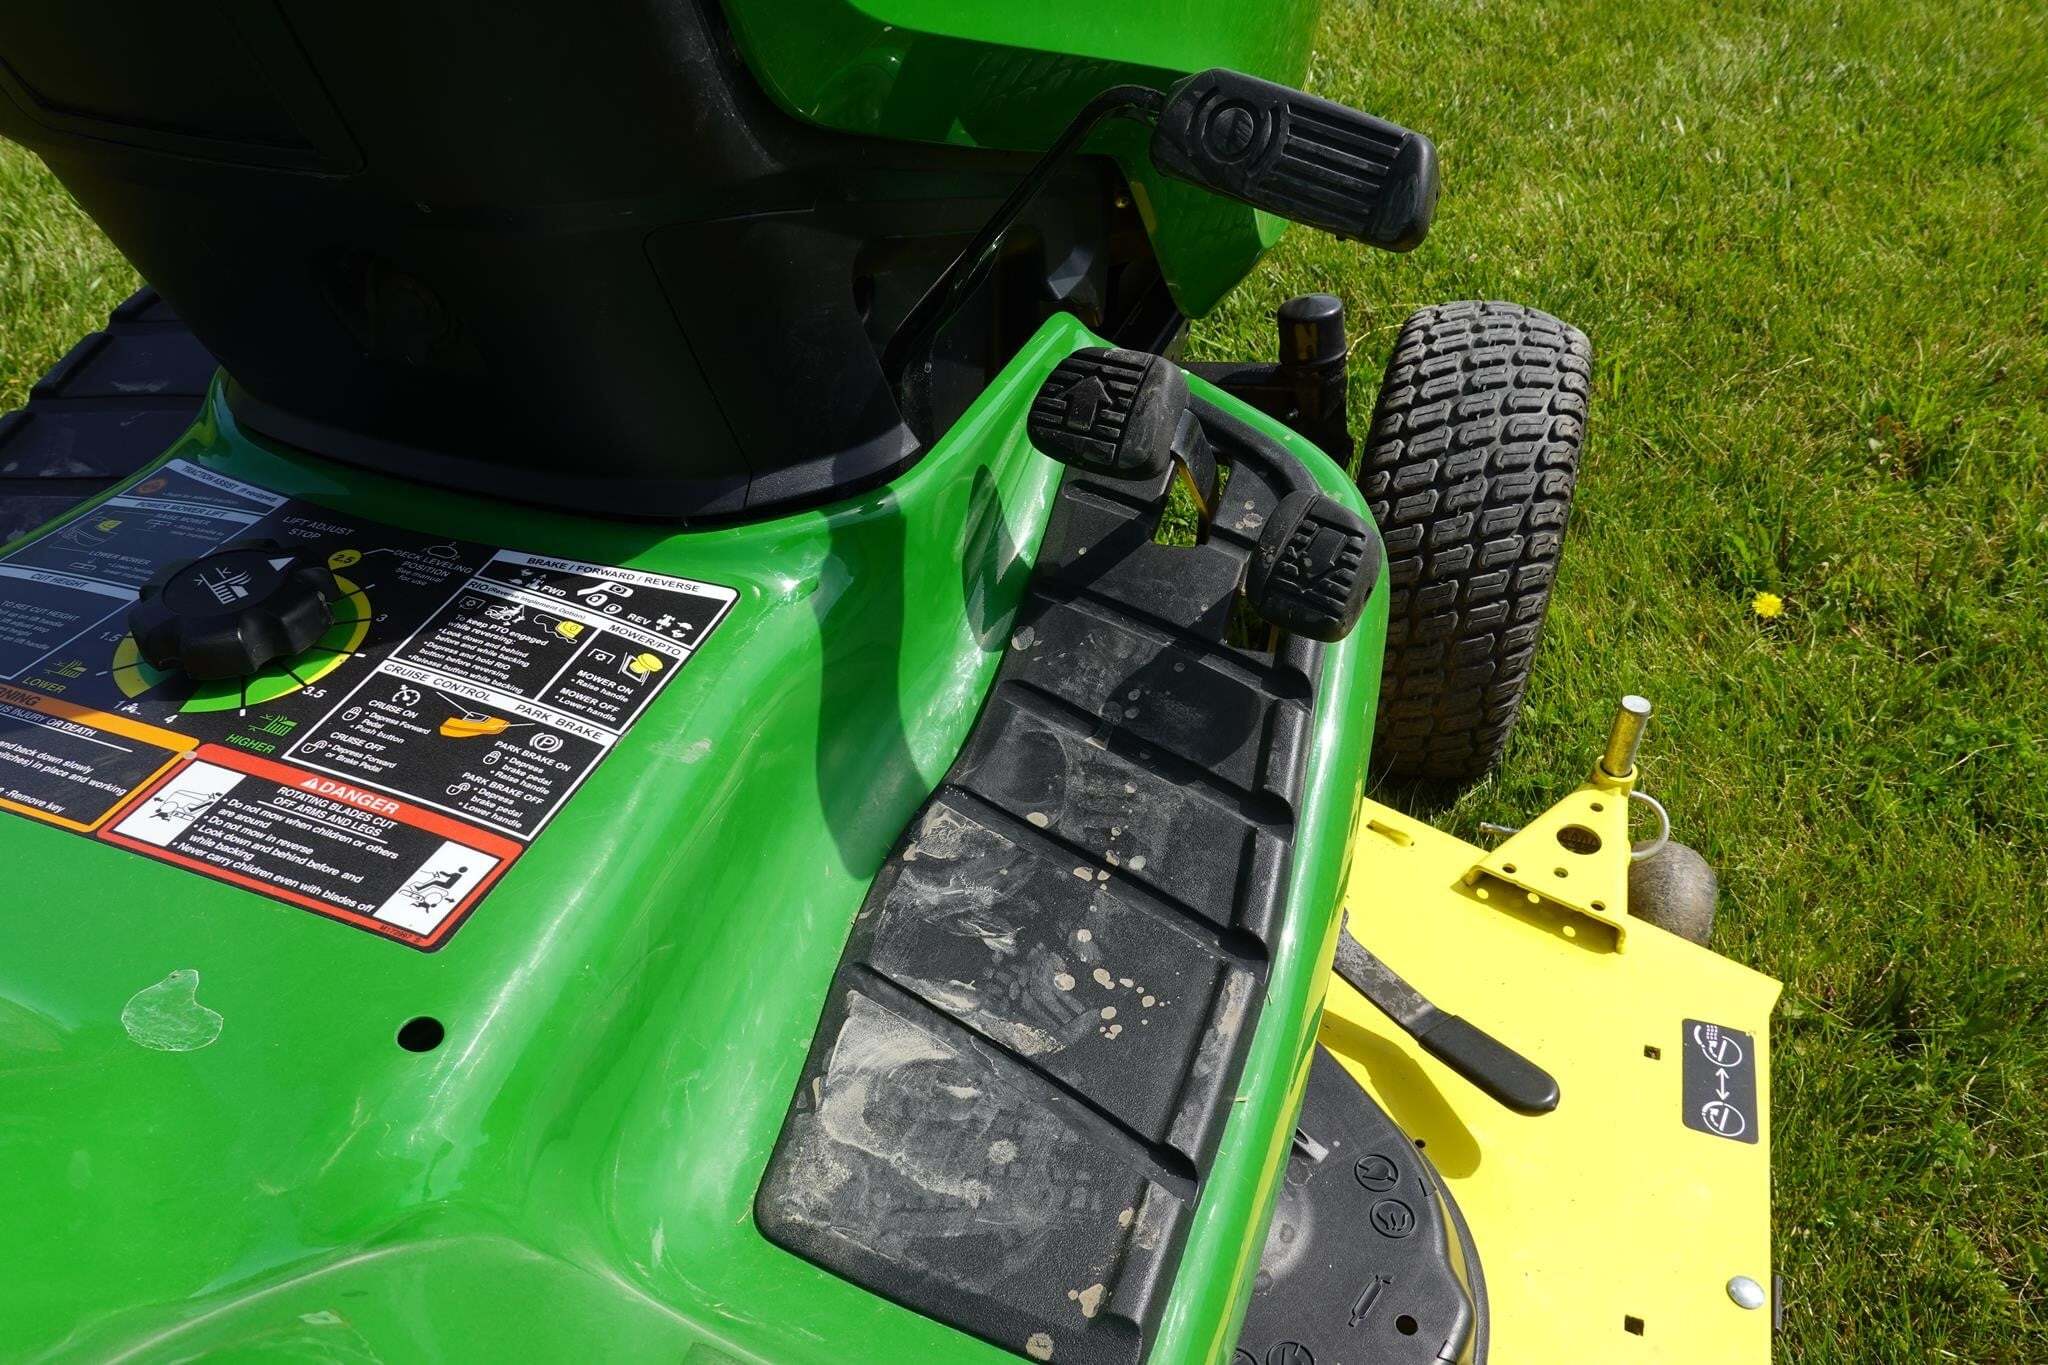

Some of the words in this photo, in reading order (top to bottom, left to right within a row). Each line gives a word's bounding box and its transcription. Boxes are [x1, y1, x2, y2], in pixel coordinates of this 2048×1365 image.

[282, 515, 309, 527] LIFT
[307, 521, 355, 536] ADJUST
[288, 529, 321, 540] STOP
[401, 561, 449, 577] POSITION
[422, 557, 474, 574] LEVELING
[526, 557, 567, 570] BRAKE
[576, 564, 636, 582] FORWARD
[642, 576, 701, 592] REVERSE
[468, 581, 489, 591] RIO
[540, 585, 567, 598] FWD
[376, 613, 388, 623] 3
[456, 613, 466, 622] To
[466, 618, 489, 630] keep
[489, 623, 510, 634] PTO
[509, 630, 549, 647] engaged
[627, 612, 651, 625] REV
[100, 631, 122, 642] 1.5
[440, 628, 461, 639] Look
[461, 633, 485, 645] down
[484, 640, 501, 651] and
[499, 644, 530, 658] behind
[449, 620, 471, 632] while
[471, 627, 517, 645] reversing:
[608, 624, 681, 657] MOWER/PTO
[427, 641, 460, 656] Depress
[459, 650, 476, 662] and
[475, 655, 495, 667] hold
[494, 660, 511, 671] RIO
[435, 634, 461, 647] before
[460, 641, 477, 652] and
[476, 646, 498, 658] while
[497, 651, 530, 668] backing
[411, 653, 442, 669] Release
[442, 662, 469, 677] button
[469, 670, 491, 684] while
[491, 678, 524, 695] backing
[418, 648, 445, 661] button
[444, 655, 472, 669] before
[470, 663, 510, 681] reversing
[22, 677, 67, 694] LOWER
[302, 685, 327, 699] 3.5
[384, 663, 431, 682] CRUISE
[433, 677, 492, 702] CONTROL
[575, 679, 600, 693] Raise
[600, 688, 629, 703] handle
[577, 669, 617, 689] MOWER
[616, 683, 634, 695] ON
[0, 687, 40, 707] NING
[369, 699, 404, 714] CRUISE
[402, 708, 419, 720] ON
[558, 695, 587, 711] Lower
[586, 706, 617, 722] handle
[560, 687, 599, 706] MOWER
[598, 700, 621, 714] OFF
[11, 707, 49, 722] INJURY
[46, 718, 62, 728] OR
[60, 721, 97, 738] DEATH
[164, 713, 178, 724] 4
[361, 718, 385, 730] Pedal
[369, 711, 399, 726] Depress
[398, 721, 431, 736] Forward
[514, 704, 553, 723] PARK
[555, 717, 605, 740] BRAKE
[224, 733, 276, 754] HIGHER
[330, 731, 367, 747] CRUISE
[365, 741, 386, 752] OFF
[355, 723, 378, 736] Push
[377, 730, 405, 745] button
[16, 744, 38, 757] back
[36, 751, 63, 765] down
[62, 756, 94, 775] slowly
[325, 751, 336, 760] or
[336, 755, 360, 768] Brake
[358, 761, 383, 774] Pedal
[331, 744, 362, 759] Depress
[362, 753, 397, 769] Forward
[494, 740, 522, 755] PARK
[521, 750, 556, 767] BRAKE
[555, 762, 572, 773] ON
[509, 756, 544, 775] Depress
[31, 760, 43, 770] in
[40, 764, 70, 778] place
[68, 771, 91, 784] and
[88, 778, 128, 797] working
[494, 770, 519, 785] Raise
[519, 779, 550, 796] handle
[502, 764, 527, 778] brake
[526, 773, 553, 787] pedal
[317, 780, 400, 815] DANGER
[462, 771, 490, 787] PARK
[488, 781, 524, 799] BRAKE
[523, 793, 545, 806] OFF
[478, 787, 515, 806] Depress
[45, 802, 66, 814] key
[218, 808, 236, 818] are
[234, 813, 272, 829] around
[272, 796, 297, 808] OFF
[294, 803, 328, 820] ARMS
[325, 813, 352, 828] AND
[350, 822, 382, 837] LEGS
[277, 786, 328, 808] ROTATING
[327, 801, 372, 822] BLADES
[371, 816, 398, 830] CUT
[462, 801, 491, 818] Lower
[491, 811, 522, 829] handle
[470, 795, 496, 809] brake
[495, 803, 523, 819] pedal
[207, 815, 224, 826] Do
[222, 820, 243, 832] not
[241, 827, 266, 839] mow
[264, 833, 278, 843] in
[276, 838, 315, 855] reverse
[227, 798, 243, 809] Do
[242, 804, 261, 815] not
[259, 809, 286, 822] mow
[285, 816, 313, 831] when
[312, 824, 353, 845] children
[352, 838, 367, 848] or
[365, 844, 399, 860] others
[189, 833, 216, 848] while
[214, 841, 255, 862] backing
[198, 824, 226, 838] Look
[223, 833, 252, 847] down
[251, 841, 274, 854] and
[271, 847, 309, 864] behind
[306, 859, 340, 876] before
[340, 870, 364, 884] and
[176, 841, 208, 857] Never
[206, 852, 234, 866] carry
[232, 860, 275, 879] children
[272, 874, 301, 888] even
[299, 881, 323, 896] with
[321, 889, 360, 909] blades
[357, 901, 376, 913] off
